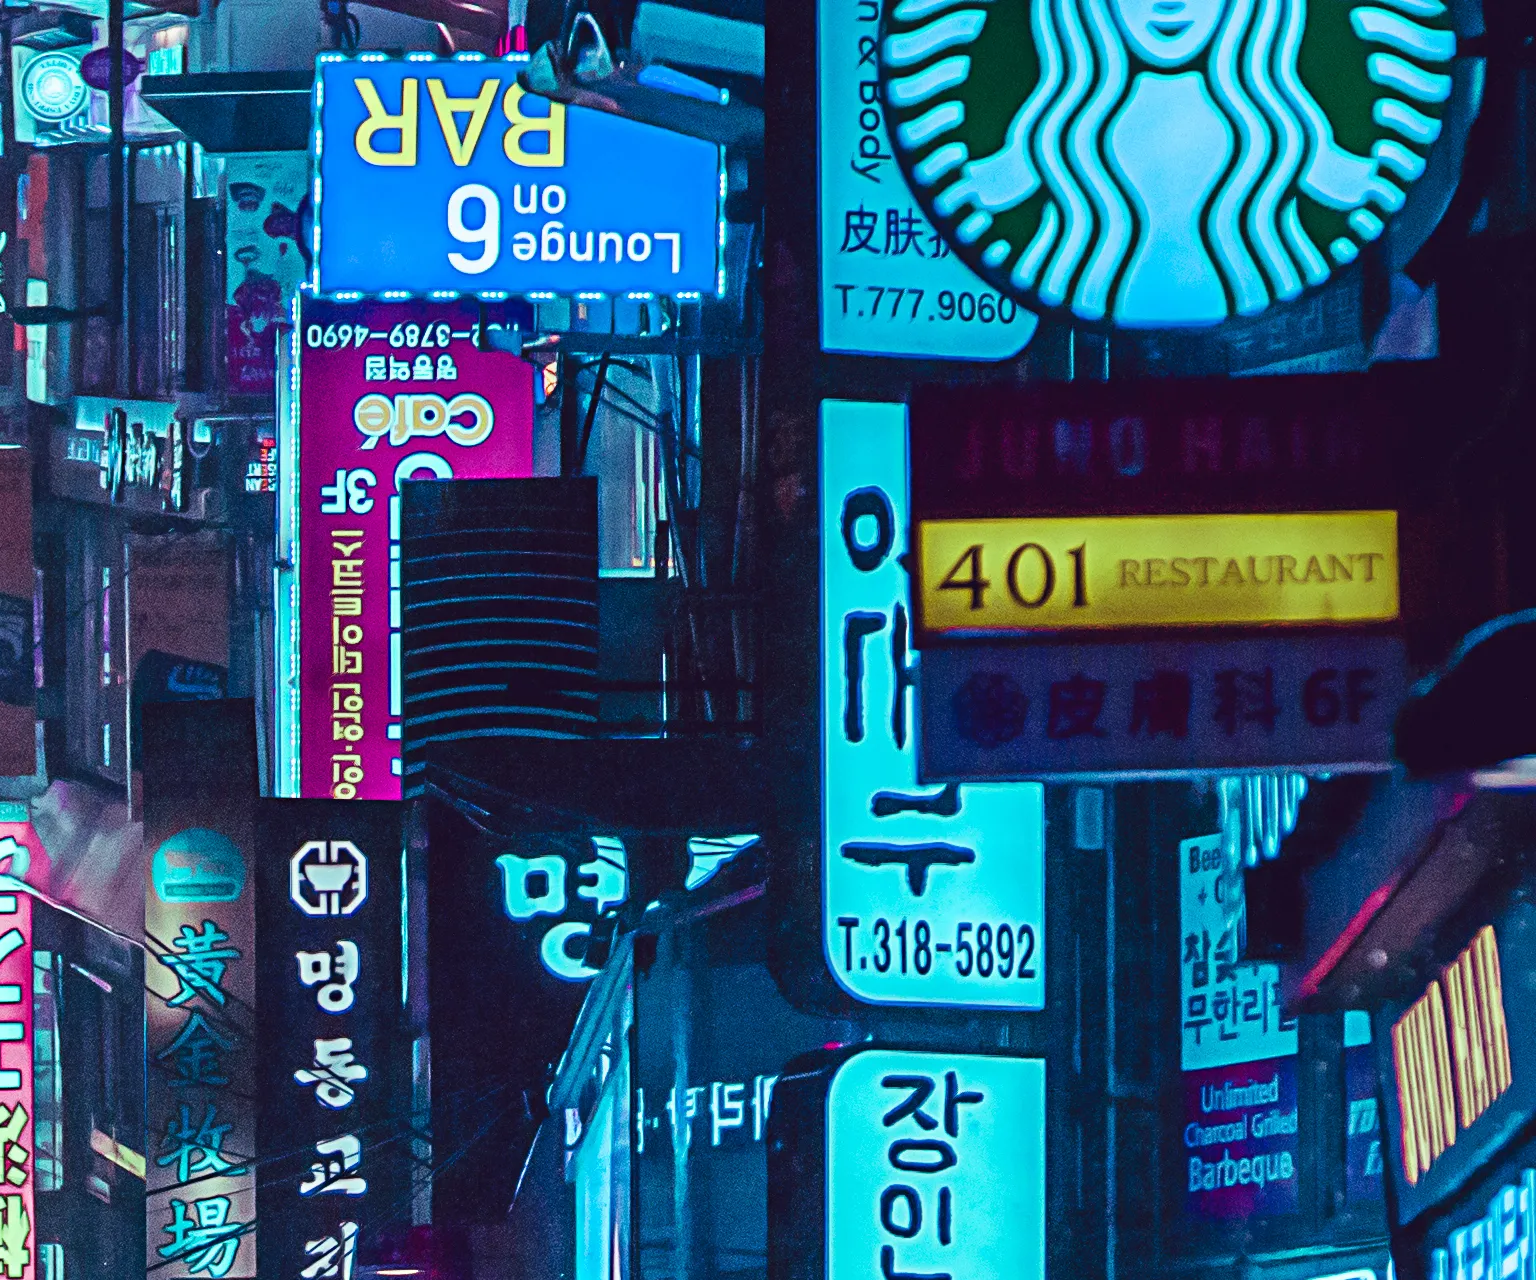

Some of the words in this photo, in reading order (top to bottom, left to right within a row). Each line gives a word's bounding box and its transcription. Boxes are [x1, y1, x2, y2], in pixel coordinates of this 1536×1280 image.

[351, 76, 566, 168] BAR
[512, 182, 566, 214] on
[445, 182, 501, 275] 6
[511, 221, 681, 273] Lounge
[833, 284, 1018, 327] T.777.9060
[363, 353, 456, 381] 명동역점
[351, 391, 494, 449] Café
[320, 466, 377, 514] 3F
[935, 540, 1092, 612] 401
[1118, 552, 1386, 592] RESTAURANT
[1189, 847, 1222, 874] Bee
[838, 916, 1037, 980] T.318-5892
[1200, 1074, 1280, 1112] Unlimited
[1187, 1147, 1294, 1192] Barbeque
